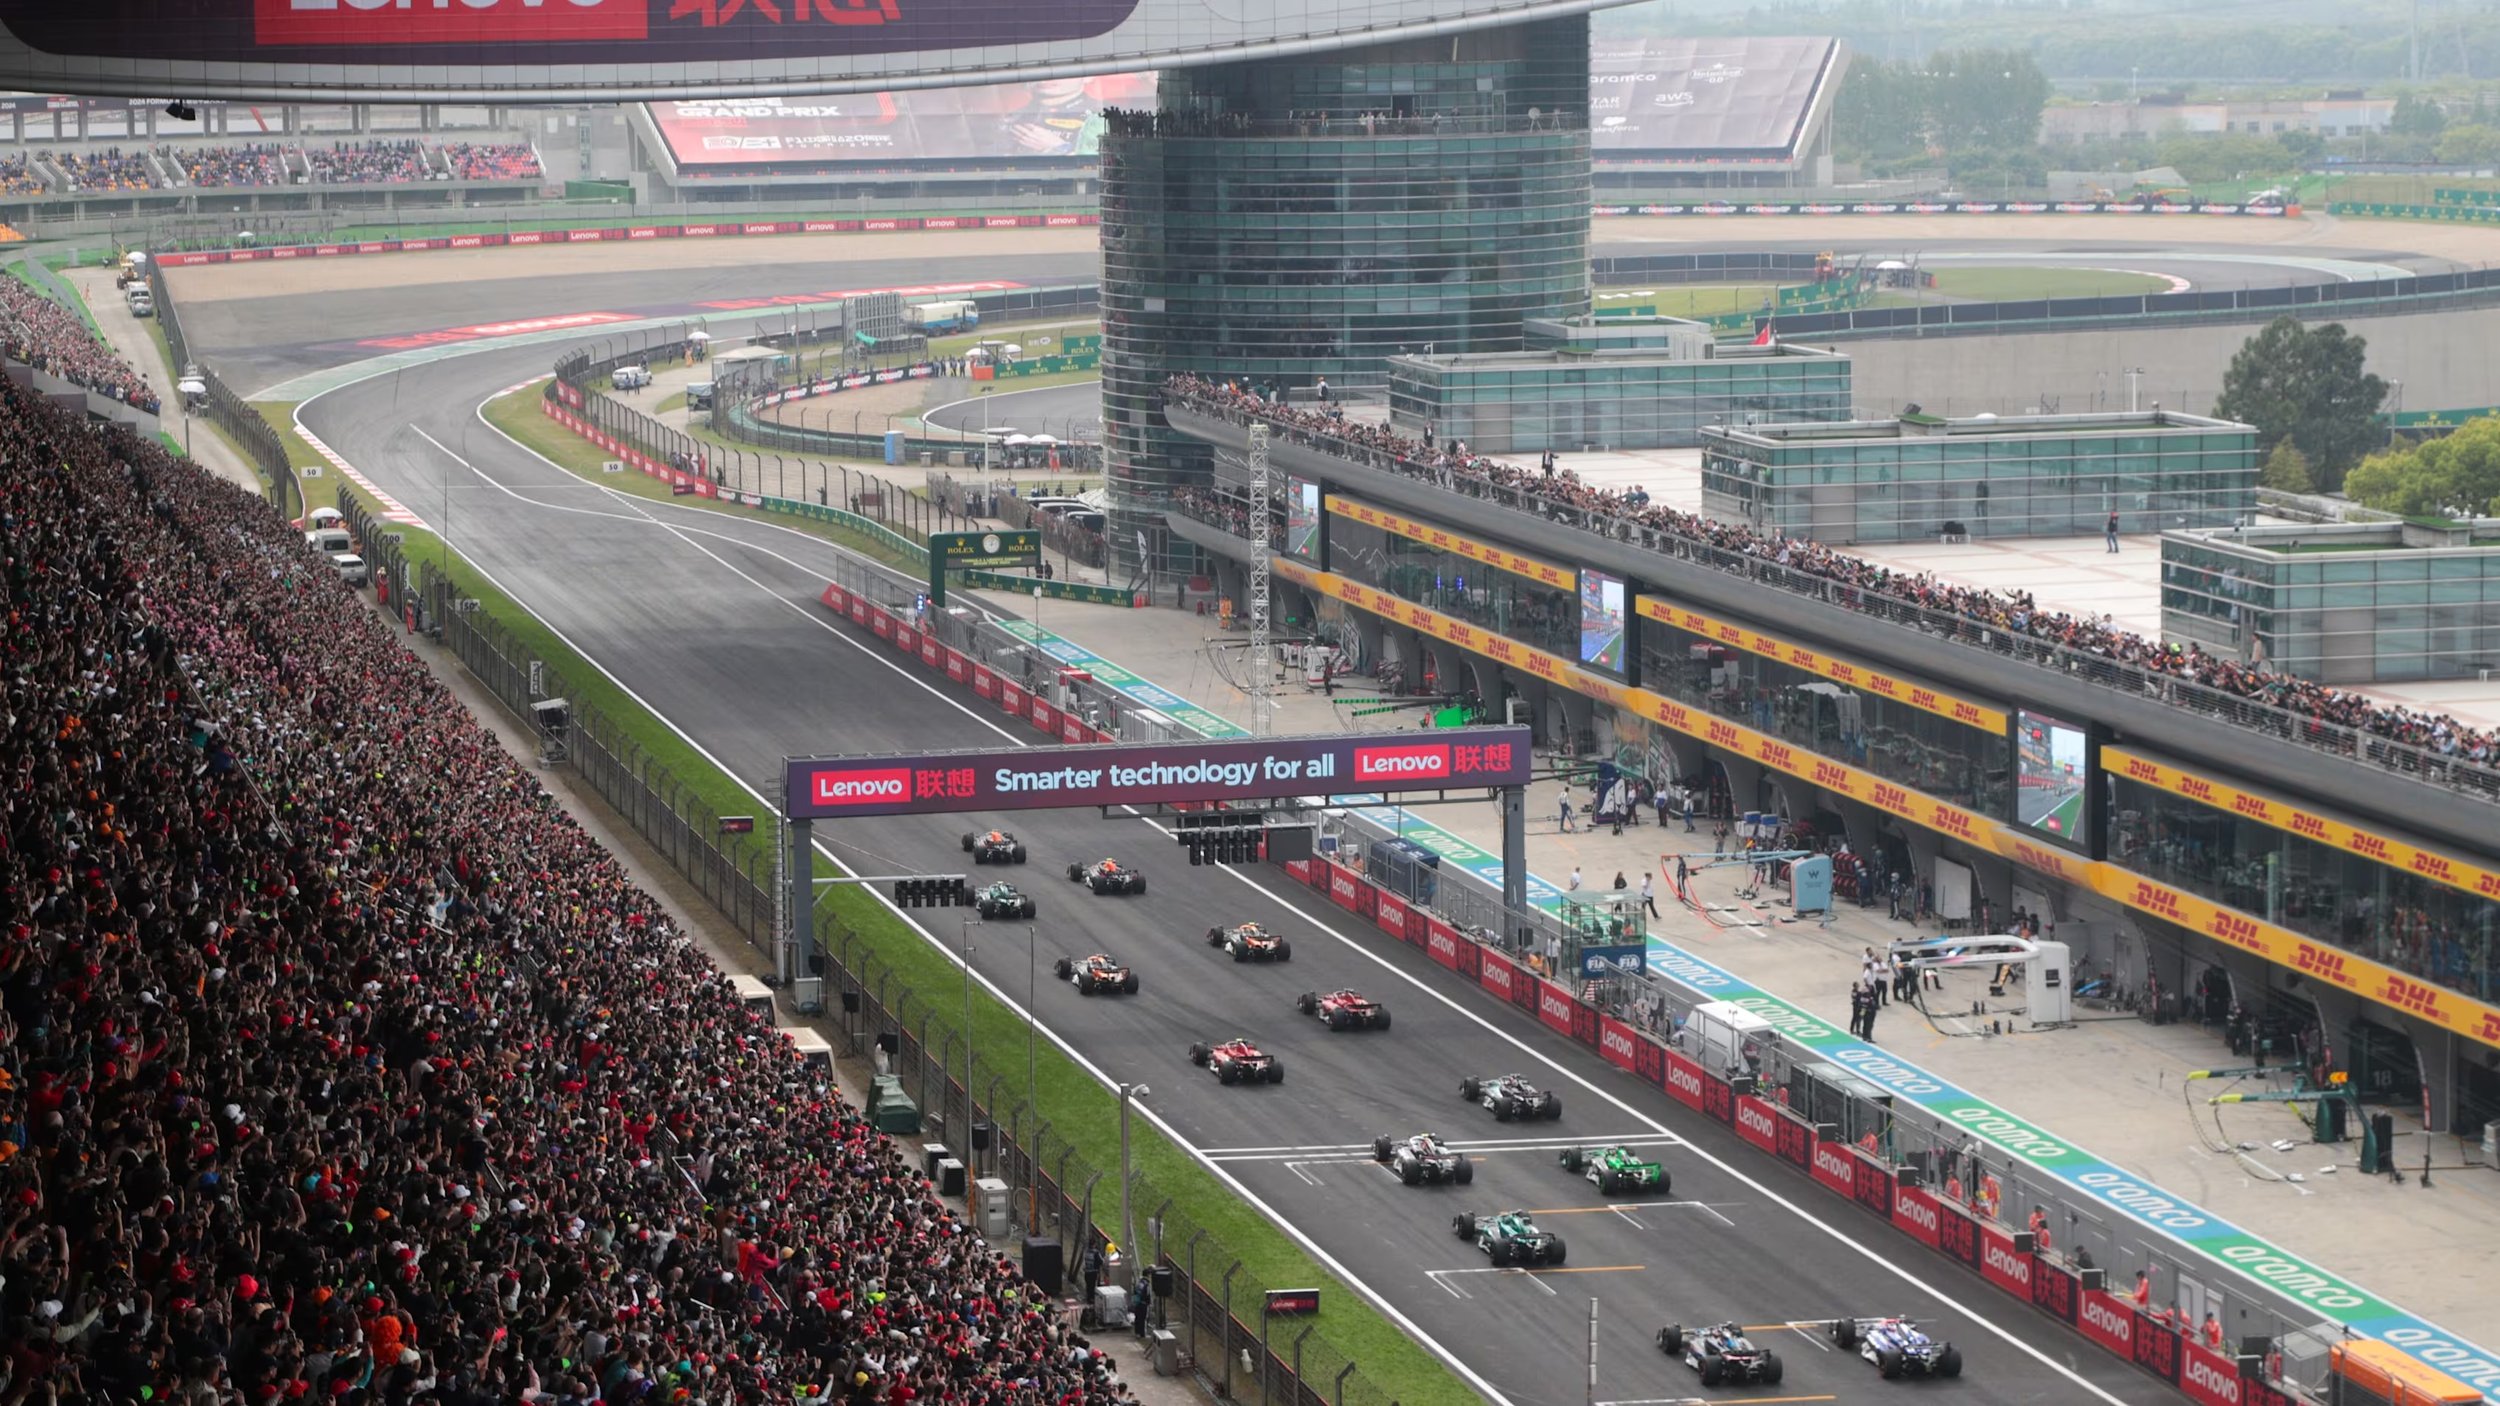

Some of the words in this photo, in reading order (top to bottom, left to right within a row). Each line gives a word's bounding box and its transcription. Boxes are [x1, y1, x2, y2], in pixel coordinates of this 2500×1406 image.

[1655, 91, 1694, 102] aws
[676, 106, 774, 118] GRAND
[777, 105, 842, 117] PRIX
[685, 226, 715, 235] Lenovo
[746, 223, 775, 233] Lenovo
[805, 221, 836, 231] Lenovo
[865, 219, 896, 230] Lenovo
[925, 218, 955, 228] Lenovo
[987, 217, 1017, 227] Lenovo
[1046, 215, 1078, 224] Lenovo
[452, 237, 480, 247] Lenovo
[511, 234, 540, 243] Lenovo
[571, 231, 600, 240] Lenovo
[631, 229, 656, 239] Lenovo
[306, 467, 317, 475] 50
[1338, 502, 1353, 515] DHL
[1360, 508, 1375, 522] DHL
[1384, 516, 1399, 530] DHL
[1408, 523, 1424, 538] DHL
[1433, 531, 1449, 546] DHL
[1459, 541, 1475, 555] DHL
[1486, 549, 1503, 565] DHL
[1513, 558, 1530, 573] DHL
[1541, 567, 1559, 584] DHL
[1342, 583, 1364, 603] DHL
[1376, 596, 1397, 617] DHL
[1653, 605, 1673, 620] DHL
[1412, 609, 1433, 631] DHL
[1686, 616, 1706, 631] DHL
[1449, 623, 1472, 646] DHL
[1721, 627, 1741, 643] DHL
[1488, 637, 1511, 660] DHL
[1756, 638, 1778, 655] DHL
[1529, 652, 1553, 677] DHL
[1792, 651, 1815, 668] DHL
[1831, 664, 1854, 681] DHL
[1872, 676, 1894, 694] DHL
[1912, 690, 1936, 708] DHL
[1660, 703, 1688, 728] DHL
[1955, 703, 1981, 723] DHL
[1710, 722, 1740, 748] DHL
[1363, 751, 1442, 773] Lenovo
[1454, 744, 1511, 773] 联想
[1762, 741, 1793, 768] DHL
[994, 766, 1101, 791] Smarter
[1109, 757, 1257, 788] technology
[1263, 756, 1301, 780] for
[1302, 753, 1335, 778] all
[1817, 763, 1848, 791] DHL
[2129, 760, 2159, 782] DHL
[820, 776, 902, 798] Lenovo
[916, 768, 975, 798] 联想
[2181, 777, 2212, 800] DHL
[1875, 784, 1909, 813] DHL
[2236, 795, 2268, 818] DHL
[1936, 806, 1972, 837] DHL
[2292, 813, 2326, 838] DHL
[2352, 833, 2388, 858] DHL
[2415, 853, 2452, 879] DHL
[1332, 870, 1355, 899] Lenovo
[2137, 883, 2180, 918] DHL
[1379, 897, 1404, 928] Lenovo
[1429, 925, 1455, 957] Lenovo
[2215, 912, 2261, 949] DHL
[1483, 956, 1510, 988] Lenovo
[1646, 950, 1731, 986] aramco
[2298, 944, 2350, 984] DHL
[1541, 987, 1569, 1022] Lenovo
[2386, 976, 2441, 1017] DHL
[1735, 998, 1831, 1039] aramco
[1602, 1023, 1632, 1058] Lenovo
[1668, 1058, 1700, 1097] Lenovo
[1836, 1050, 1942, 1094] aramco
[1738, 1097, 1773, 1138] Lenovo
[1951, 1109, 2067, 1157] aramco
[1814, 1140, 1851, 1183] Lenovo
[1896, 1188, 1936, 1231] Lenovo
[2079, 1173, 2206, 1228] aramco
[1985, 1237, 2028, 1284] Lenovo
[2221, 1246, 2364, 1308] aramco
[2081, 1291, 2129, 1341] Lenovo
[2185, 1350, 2238, 1403] Lenovo
